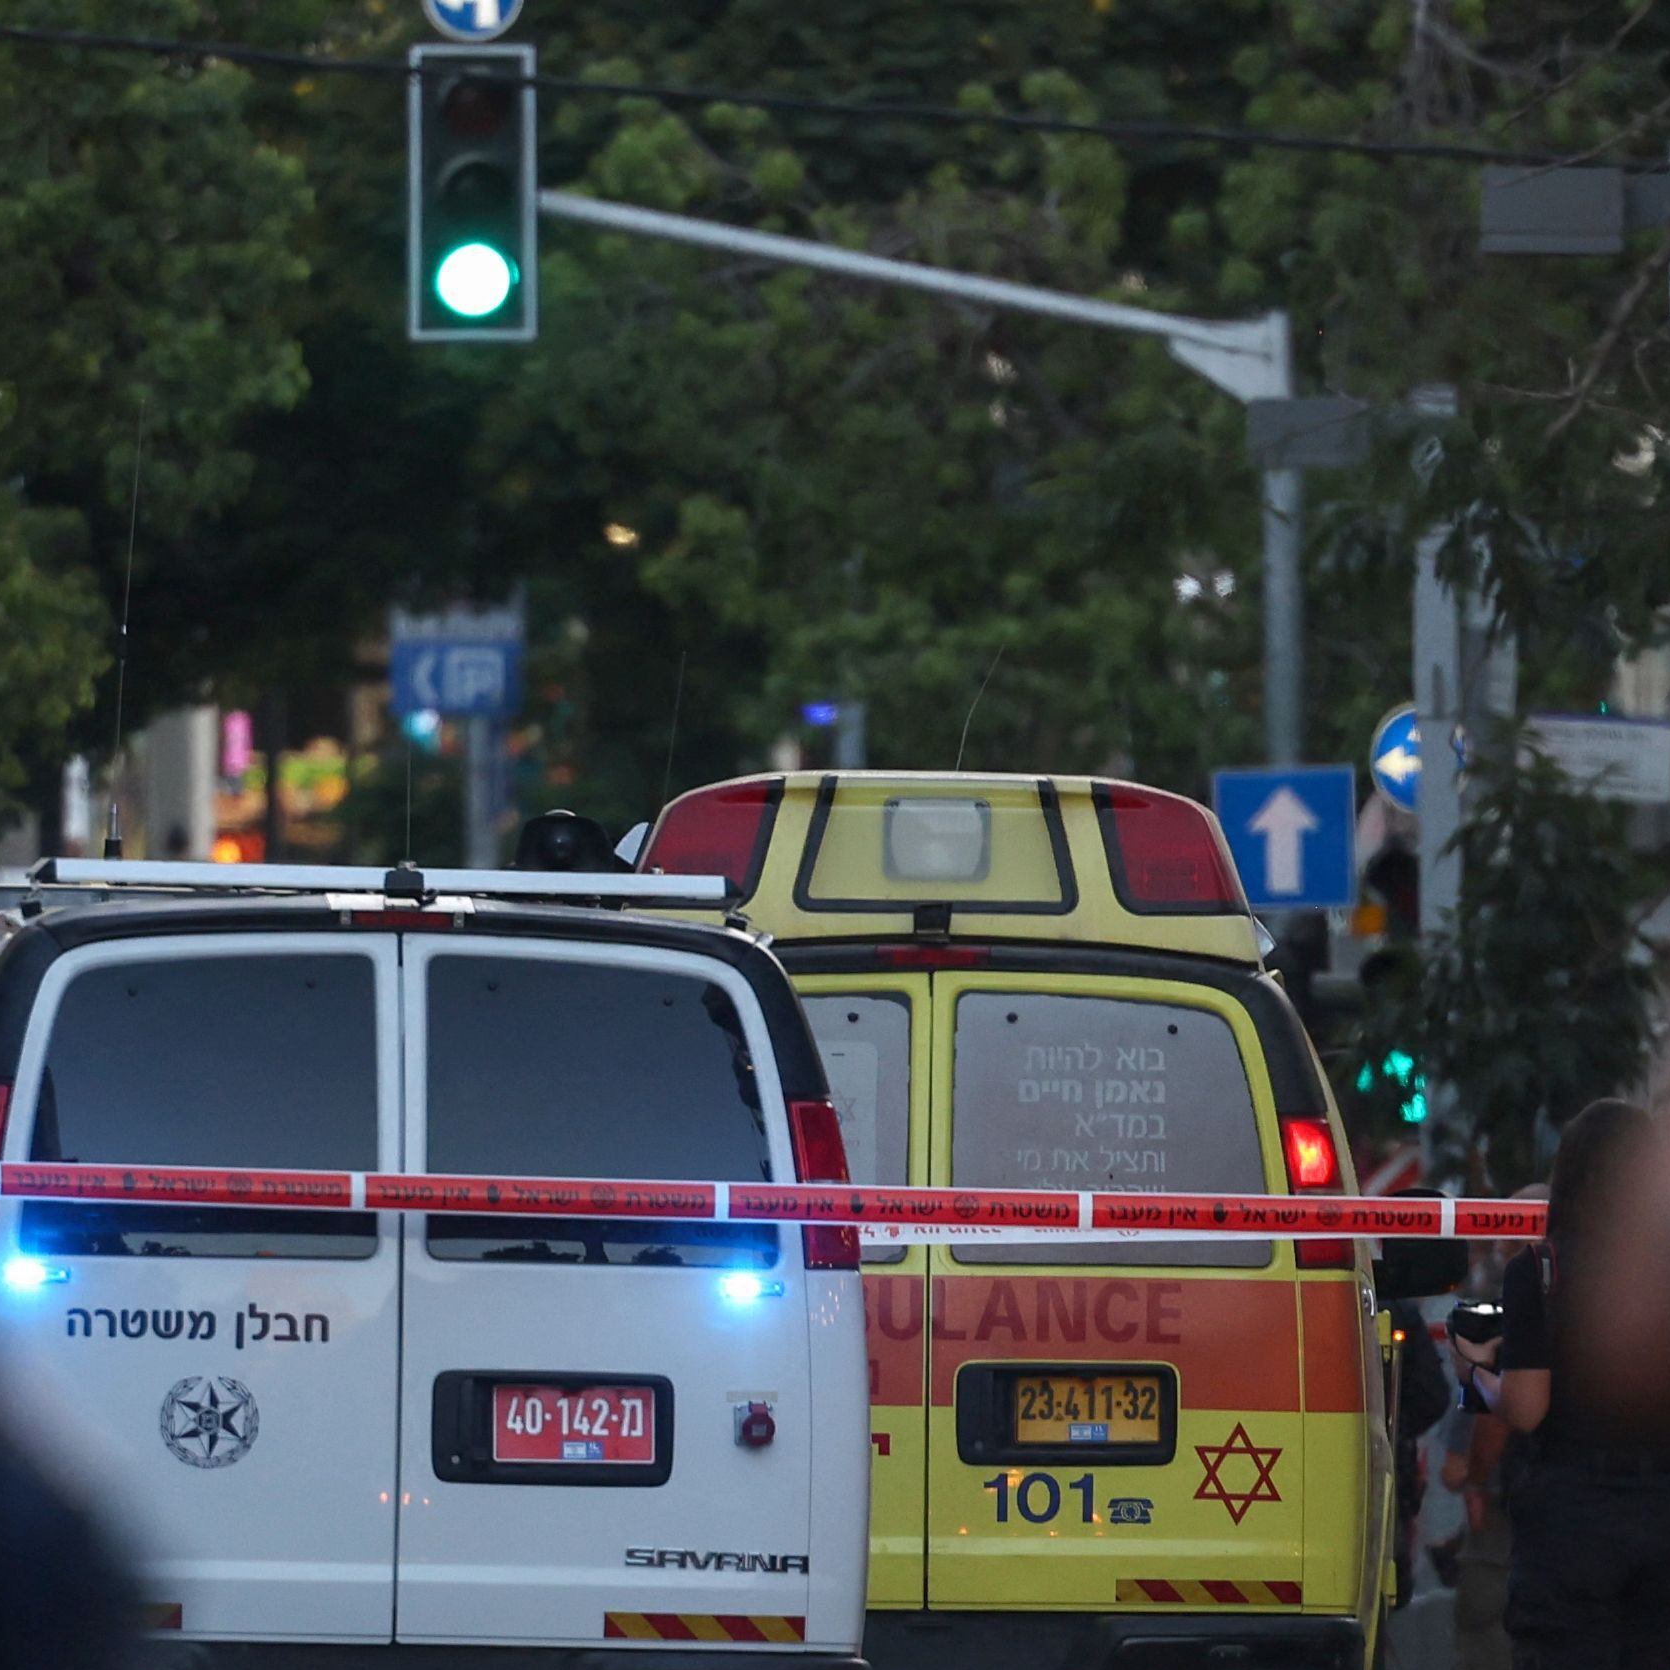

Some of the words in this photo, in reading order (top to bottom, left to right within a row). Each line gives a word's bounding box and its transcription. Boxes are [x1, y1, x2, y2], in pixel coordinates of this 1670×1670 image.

[1024, 1041, 1103, 1072] להיות
[1116, 1045, 1166, 1072] בוא
[1017, 1078, 1082, 1103] חיים
[1094, 1078, 1166, 1109] נאמן
[1017, 1149, 1041, 1173] מי
[1050, 1149, 1090, 1172] את
[1099, 1146, 1166, 1173] ותציל
[148, 1172, 216, 1194] ישראל
[260, 1180, 344, 1199] משטרת
[379, 1184, 434, 1202] מעבר
[440, 1185, 471, 1207] אין
[512, 1184, 580, 1206] ישראל
[625, 1190, 707, 1209] משטרת
[741, 1194, 798, 1212] מעבר
[875, 1195, 943, 1217] ישראל
[804, 1197, 835, 1220] אין
[987, 1201, 1071, 1220] משטרת
[1104, 1202, 1162, 1222] מעבר
[1168, 1204, 1198, 1226] אין
[1238, 1202, 1307, 1225] ישראל
[1351, 1211, 1433, 1227] משטרת
[1466, 1210, 1524, 1229] מעבר
[66, 1306, 217, 1341] משטרה
[234, 1302, 330, 1350] חבלן
[983, 1472, 1095, 1524] 101
